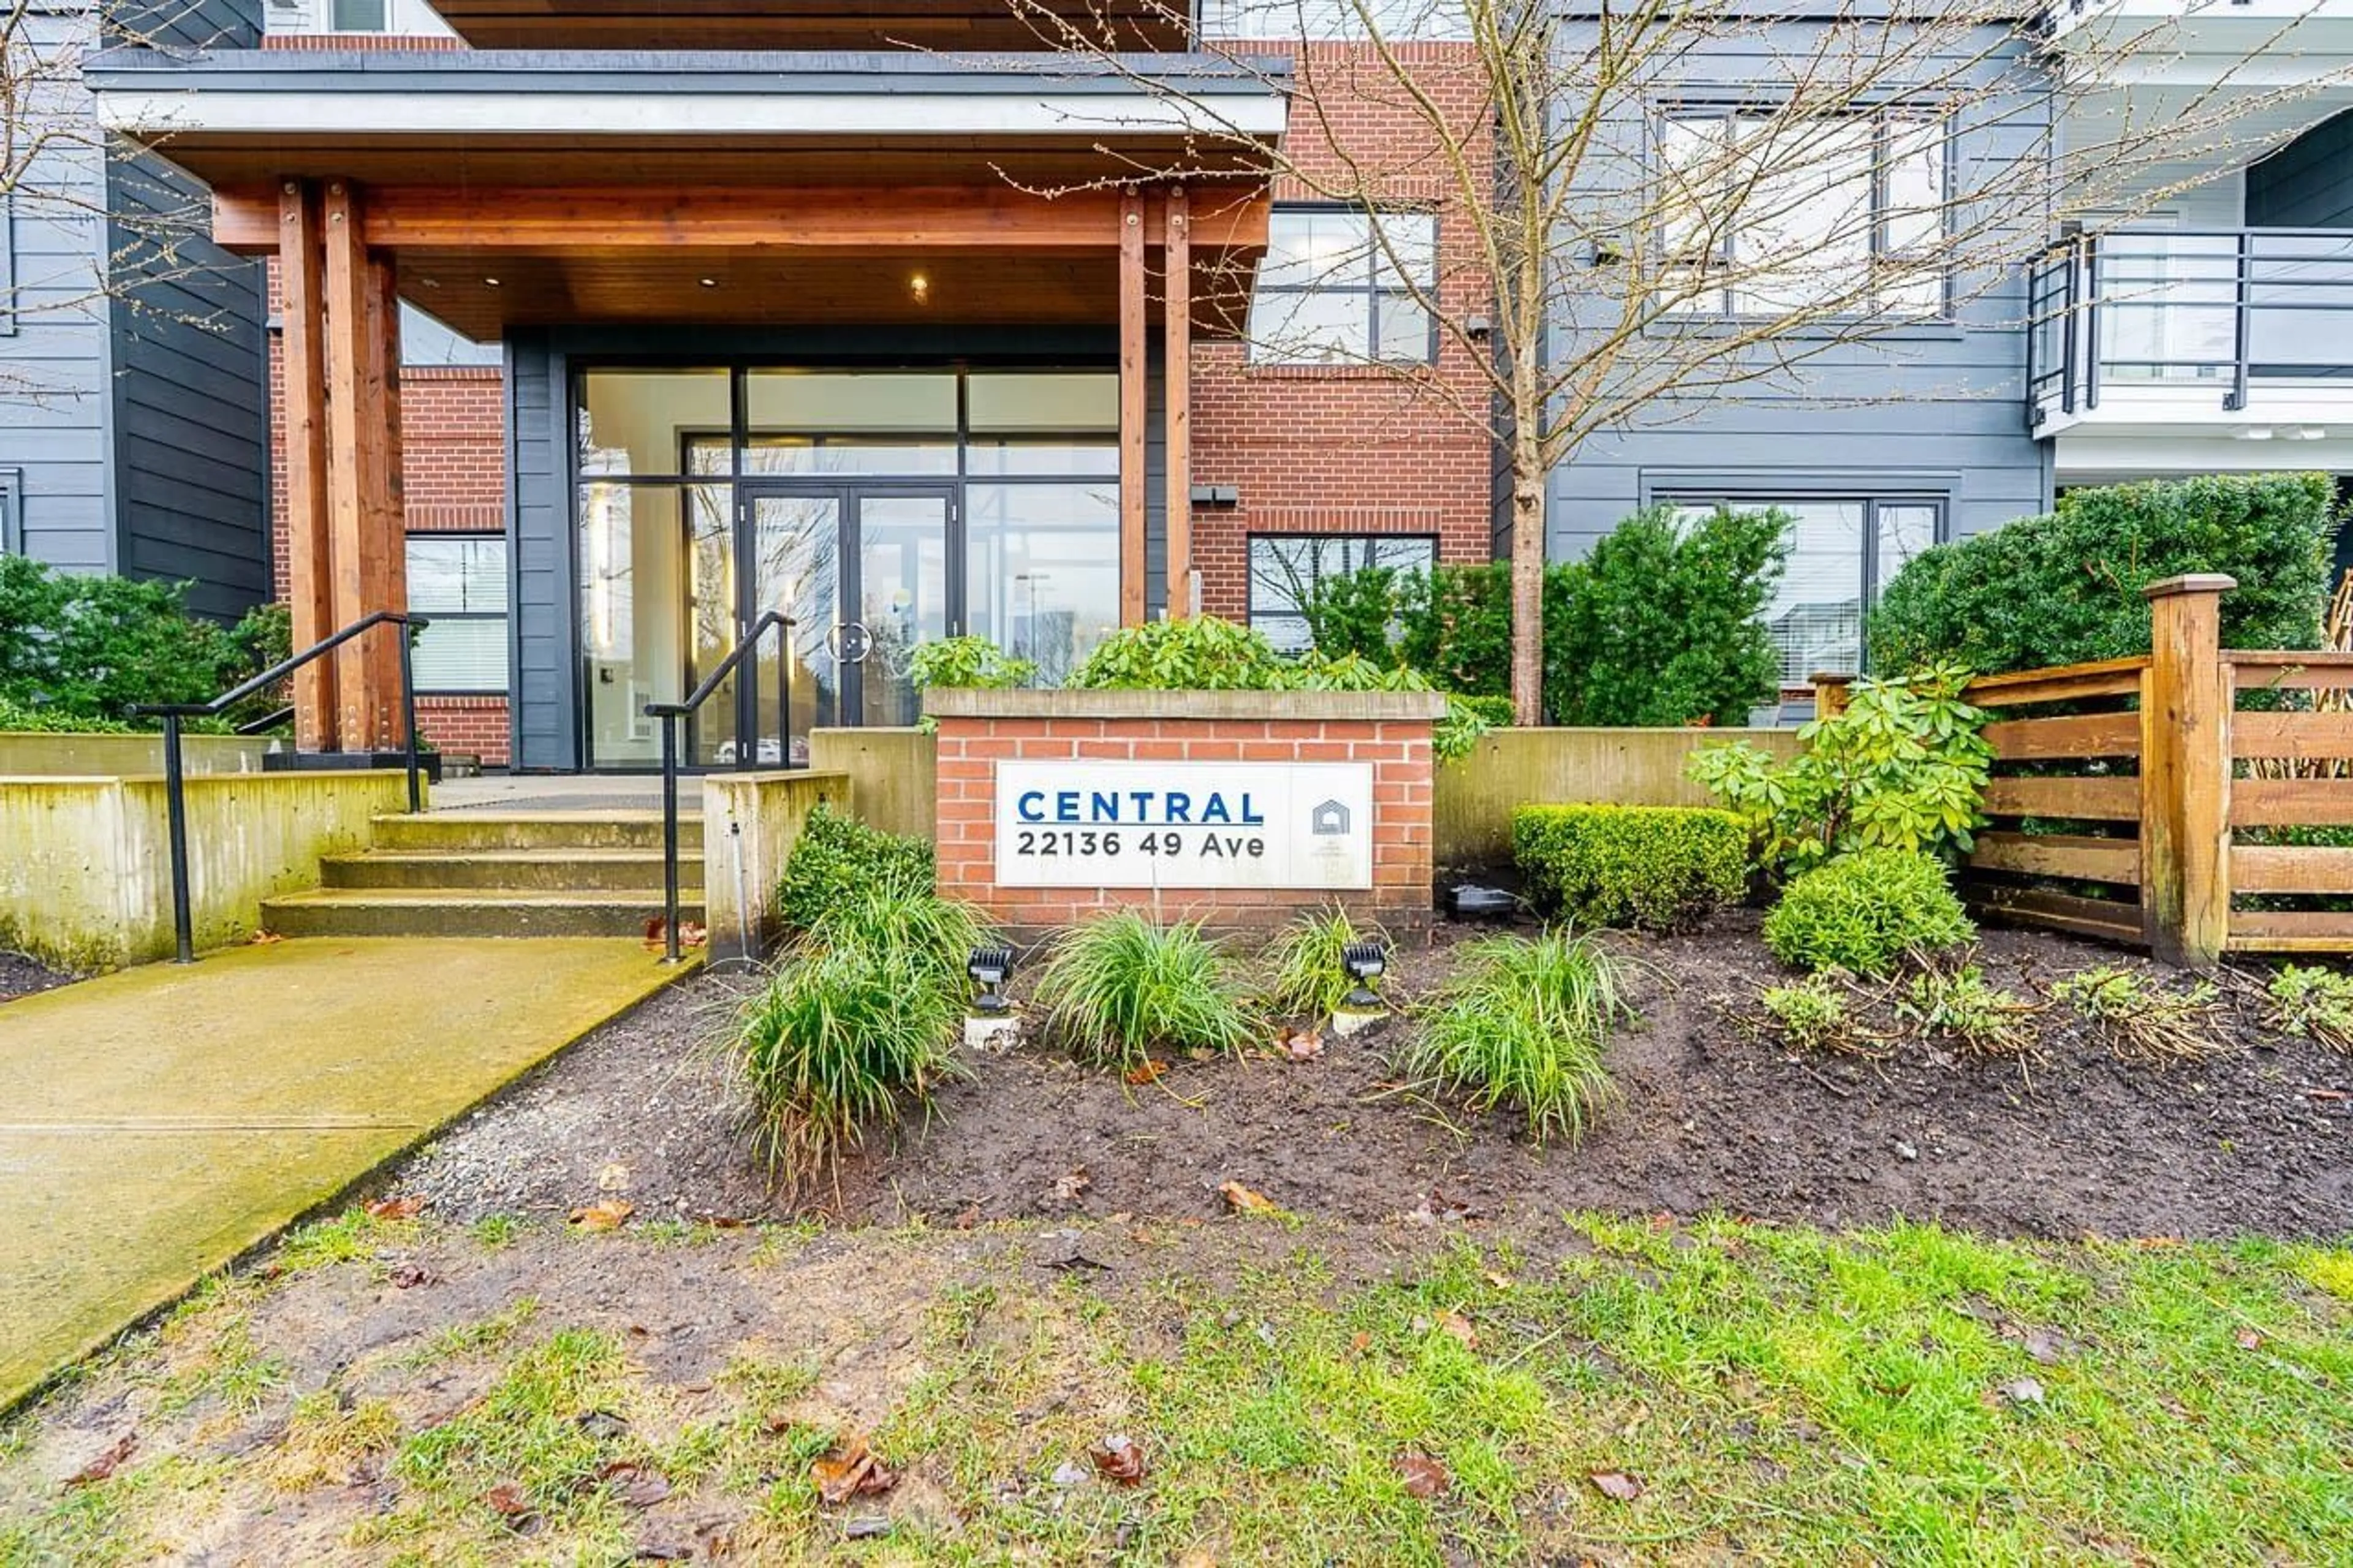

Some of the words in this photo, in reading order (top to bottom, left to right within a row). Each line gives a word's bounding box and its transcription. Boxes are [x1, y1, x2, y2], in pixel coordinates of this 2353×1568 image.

[1018, 791, 1264, 822] CENTRAL
[1017, 831, 1121, 856] 22136
[1139, 832, 1181, 856] 49
[1200, 832, 1264, 857] Ave
